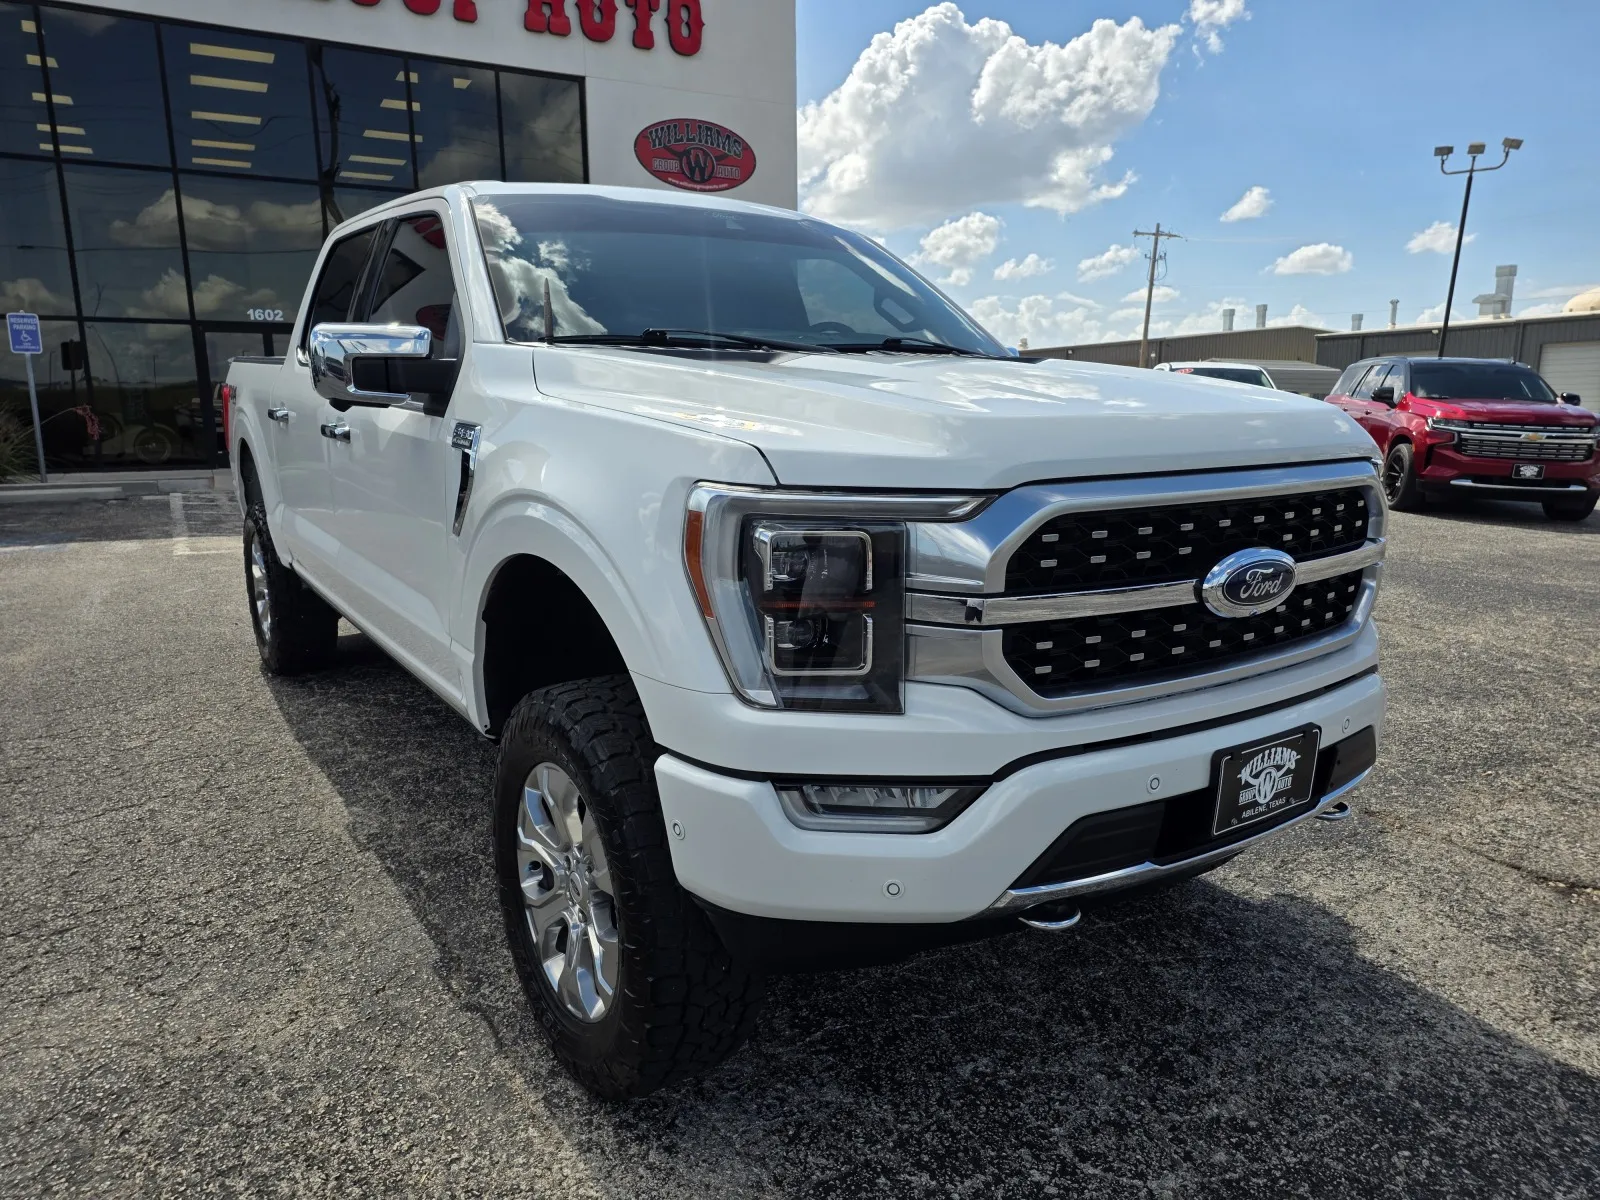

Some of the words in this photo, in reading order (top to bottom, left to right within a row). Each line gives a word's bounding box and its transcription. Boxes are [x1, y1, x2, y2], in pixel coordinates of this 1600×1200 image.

[648, 122, 743, 159] WILLIAMS
[653, 158, 680, 172] GROUP
[718, 166, 741, 179] AUTO
[246, 308, 284, 321] 1602
[1240, 567, 1284, 599] Ford
[1240, 747, 1298, 785] WILLIAMS
[1239, 789, 1257, 803] GROUP
[1277, 776, 1293, 791] AUTO
[1241, 804, 1268, 818] ABILENE,
[1269, 797, 1286, 809] TEXAS
